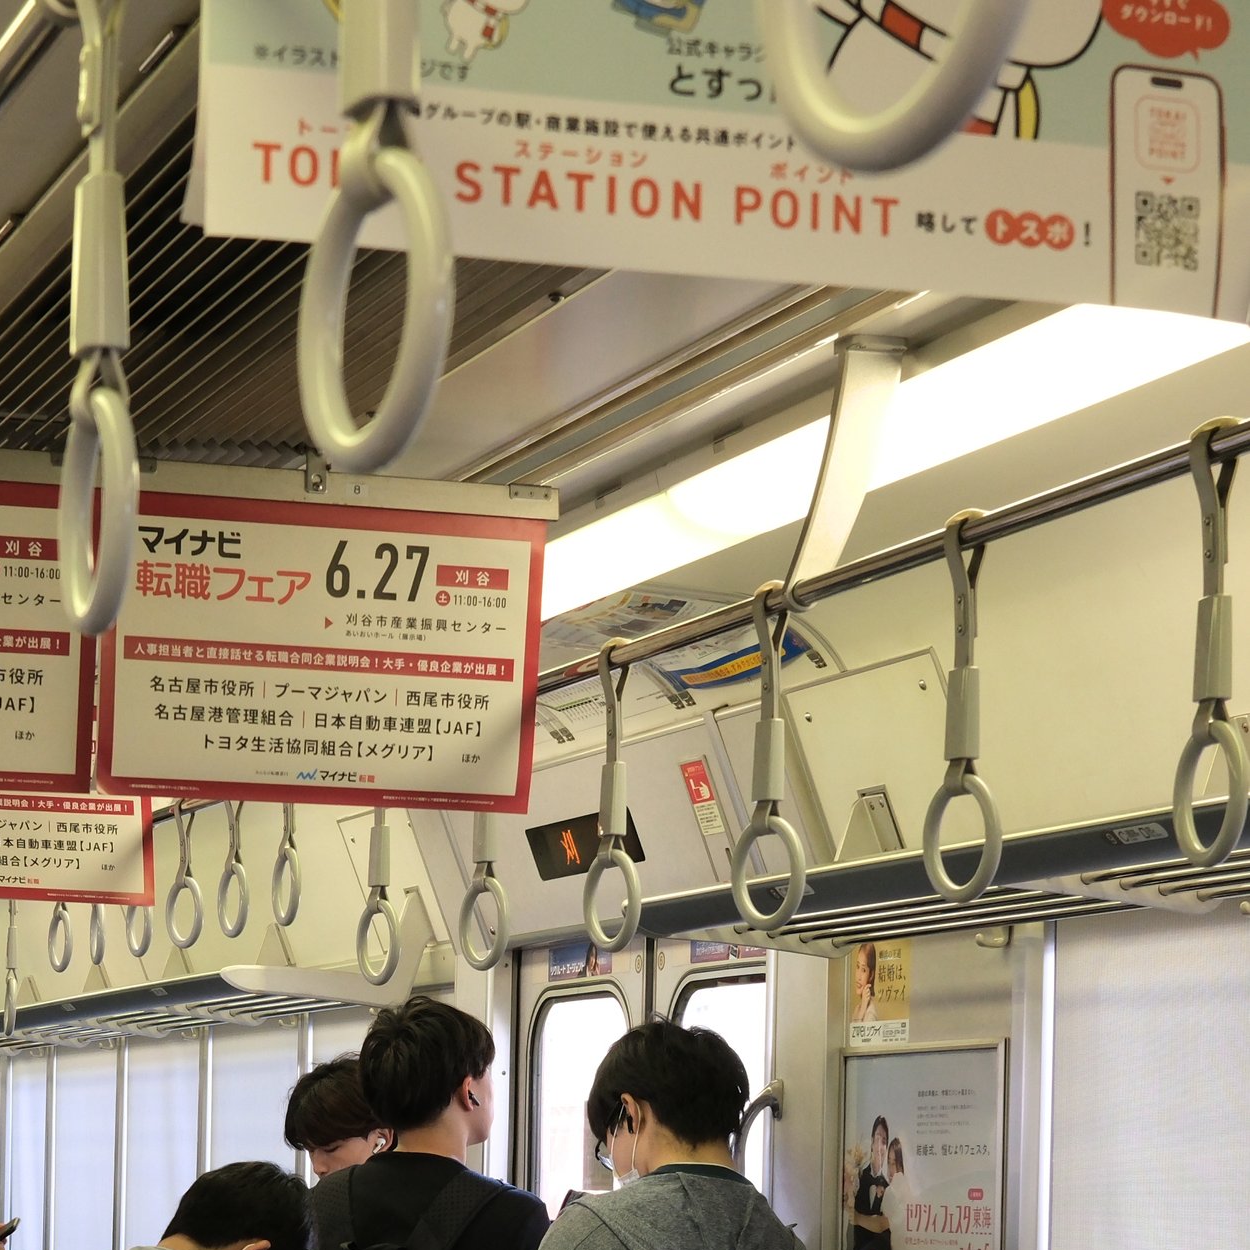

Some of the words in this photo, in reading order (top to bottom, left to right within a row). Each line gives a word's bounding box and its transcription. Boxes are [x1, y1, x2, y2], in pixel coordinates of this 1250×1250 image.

[669, 63, 776, 103] とすっ
[513, 139, 649, 168] ステーション
[253, 141, 341, 190] TO
[455, 160, 703, 223] STATION
[734, 185, 900, 238] POINT
[353, 485, 361, 495] 8
[5, 540, 43, 557] 刈谷
[138, 525, 242, 560] マイナビ
[324, 539, 431, 603] 6.27
[455, 569, 491, 587] 刈谷
[135, 560, 313, 606] 転職フェア
[453, 593, 507, 609] 11:00-16:00
[345, 612, 507, 635] 刈谷市産業振興センター
[149, 674, 255, 698] 名古屋市役所
[275, 681, 389, 704] プーマジャパン
[406, 690, 490, 711] 西尾市役所
[154, 702, 295, 728] 名古屋港管理組合
[314, 711, 483, 738] 日本自動車連盟【JAF】
[14, 729, 36, 742] ほか
[203, 733, 434, 763] トヨタ生活協同組合【メグリア】
[461, 752, 481, 764] ほか
[56, 821, 119, 836] 西尾市役所
[100, 863, 116, 872] ほか
[877, 984, 906, 1003] ツヴァイ
